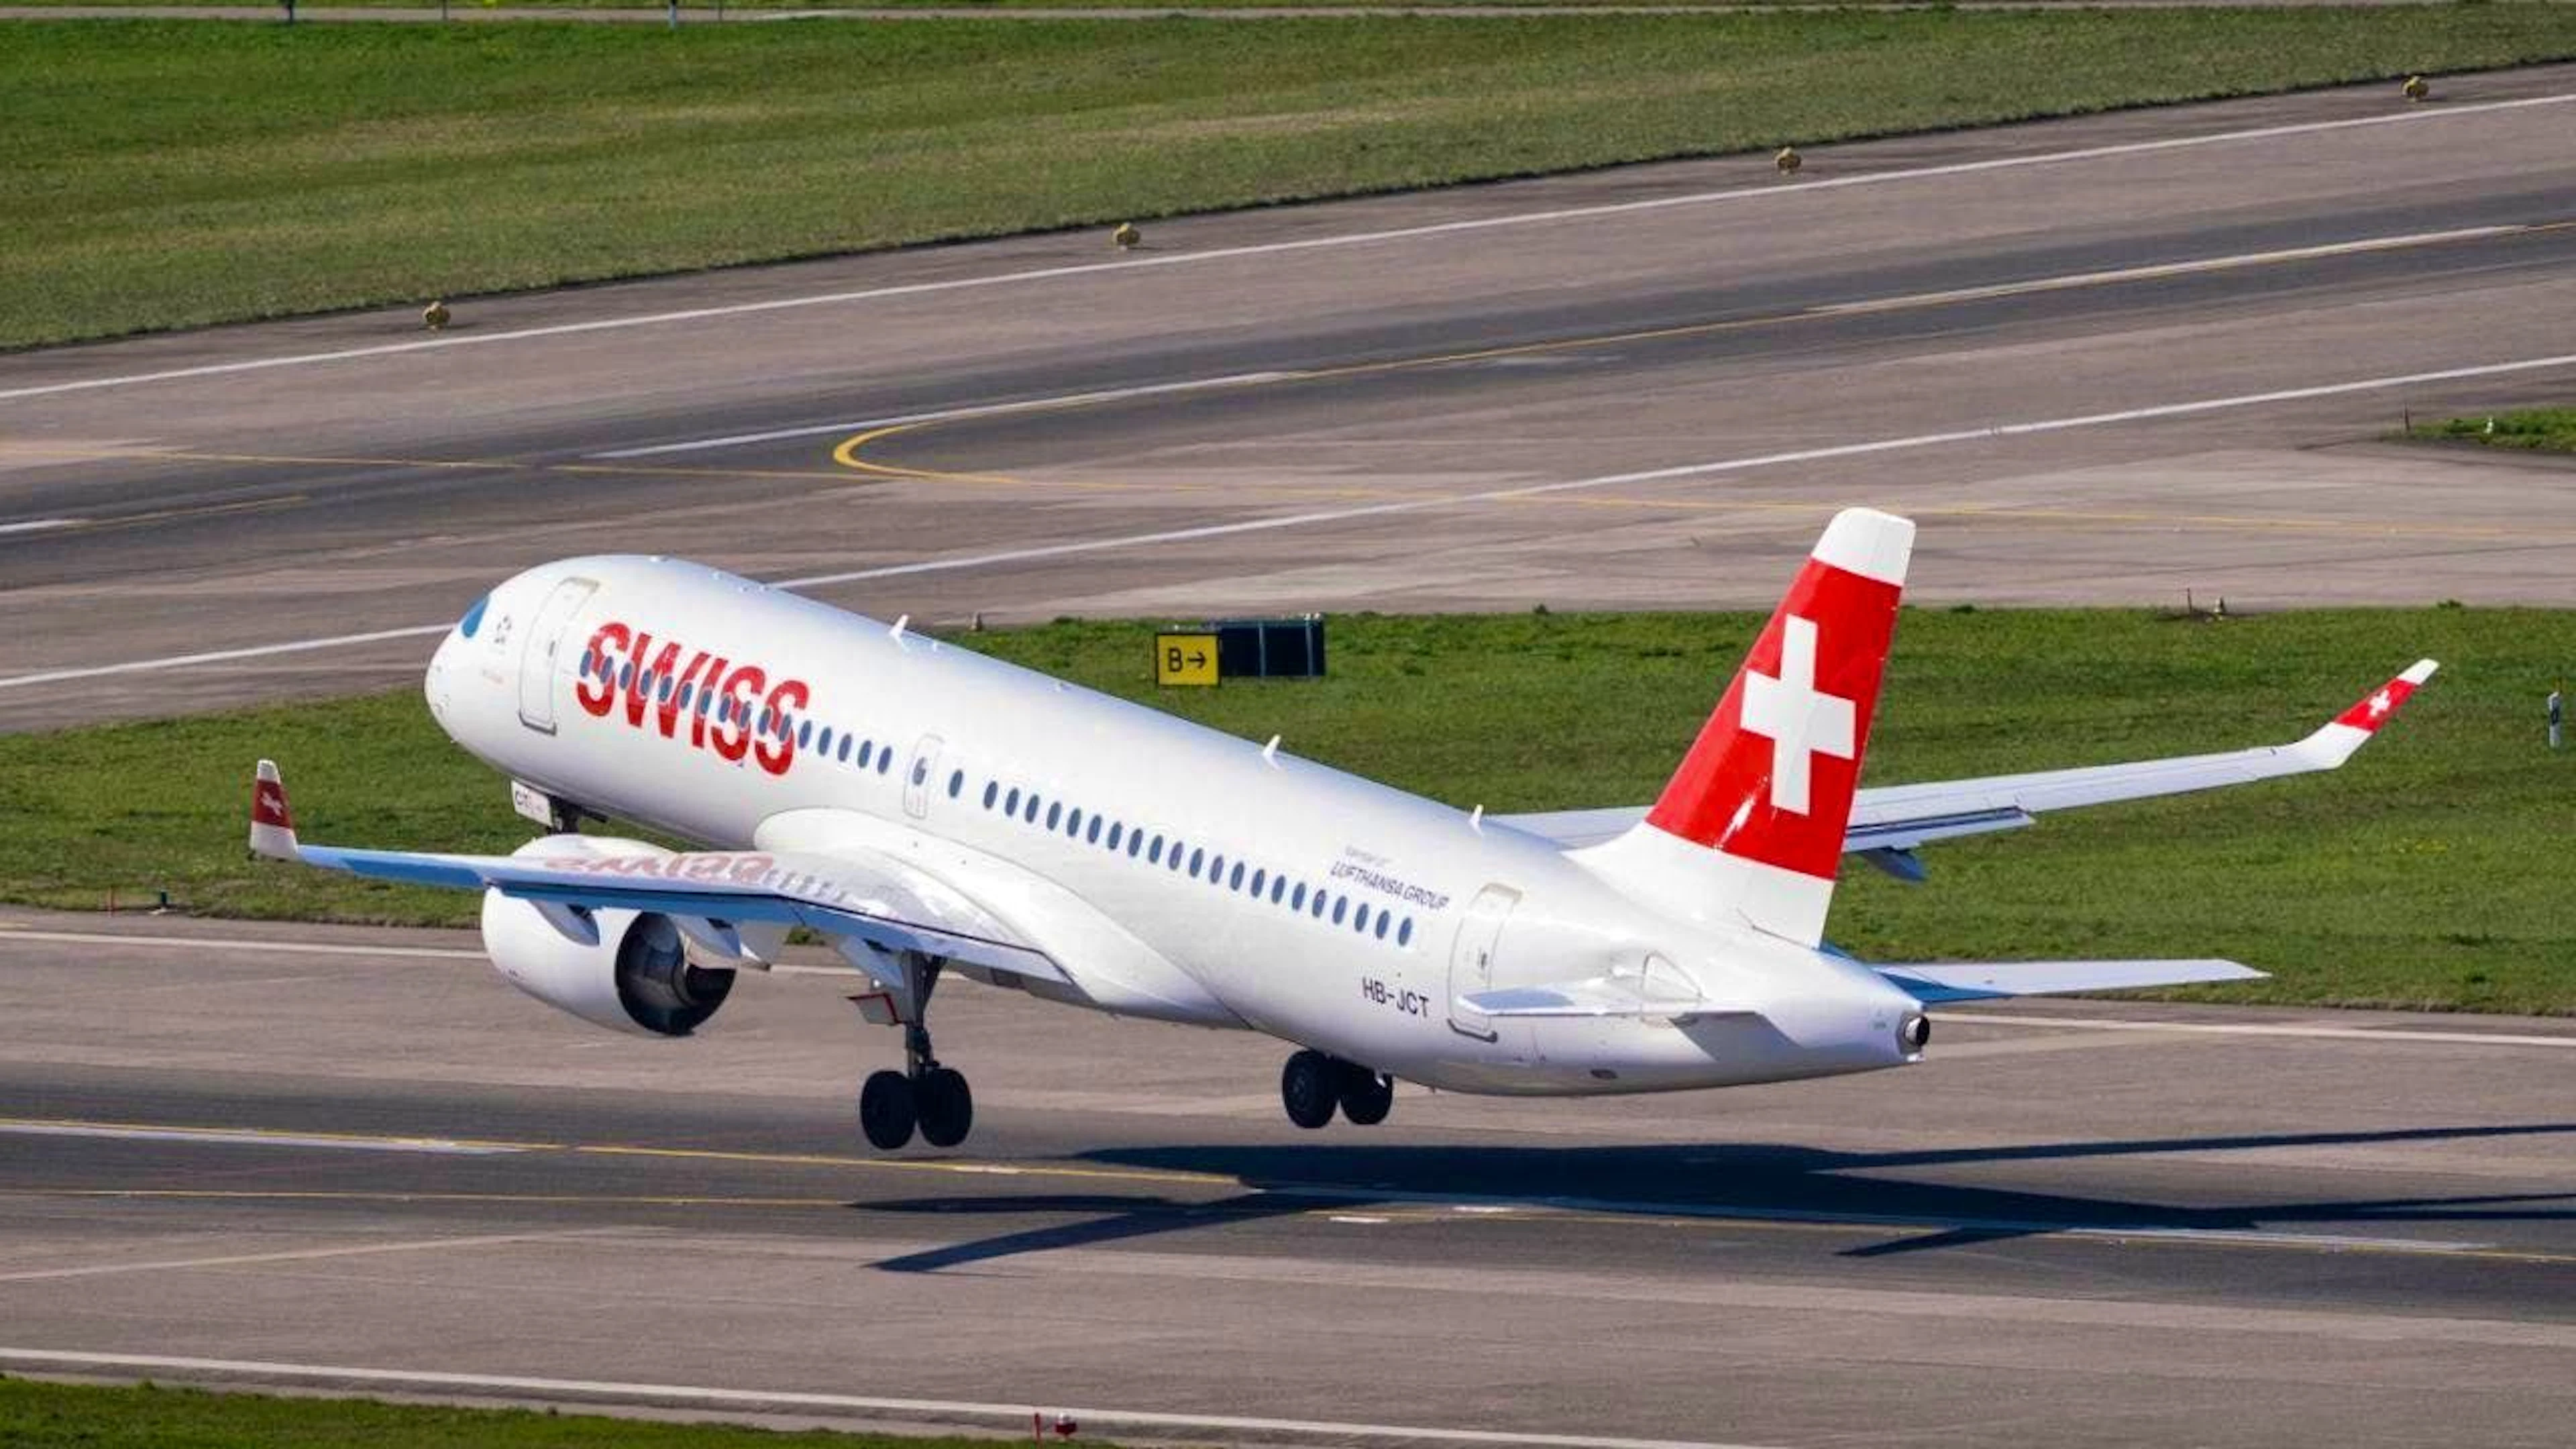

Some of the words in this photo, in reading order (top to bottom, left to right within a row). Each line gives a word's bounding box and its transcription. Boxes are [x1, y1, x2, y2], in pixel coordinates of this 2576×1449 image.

[1167, 647, 1183, 673] B
[577, 623, 809, 775] SWISS
[1362, 977, 1430, 1018] HB-JCT
